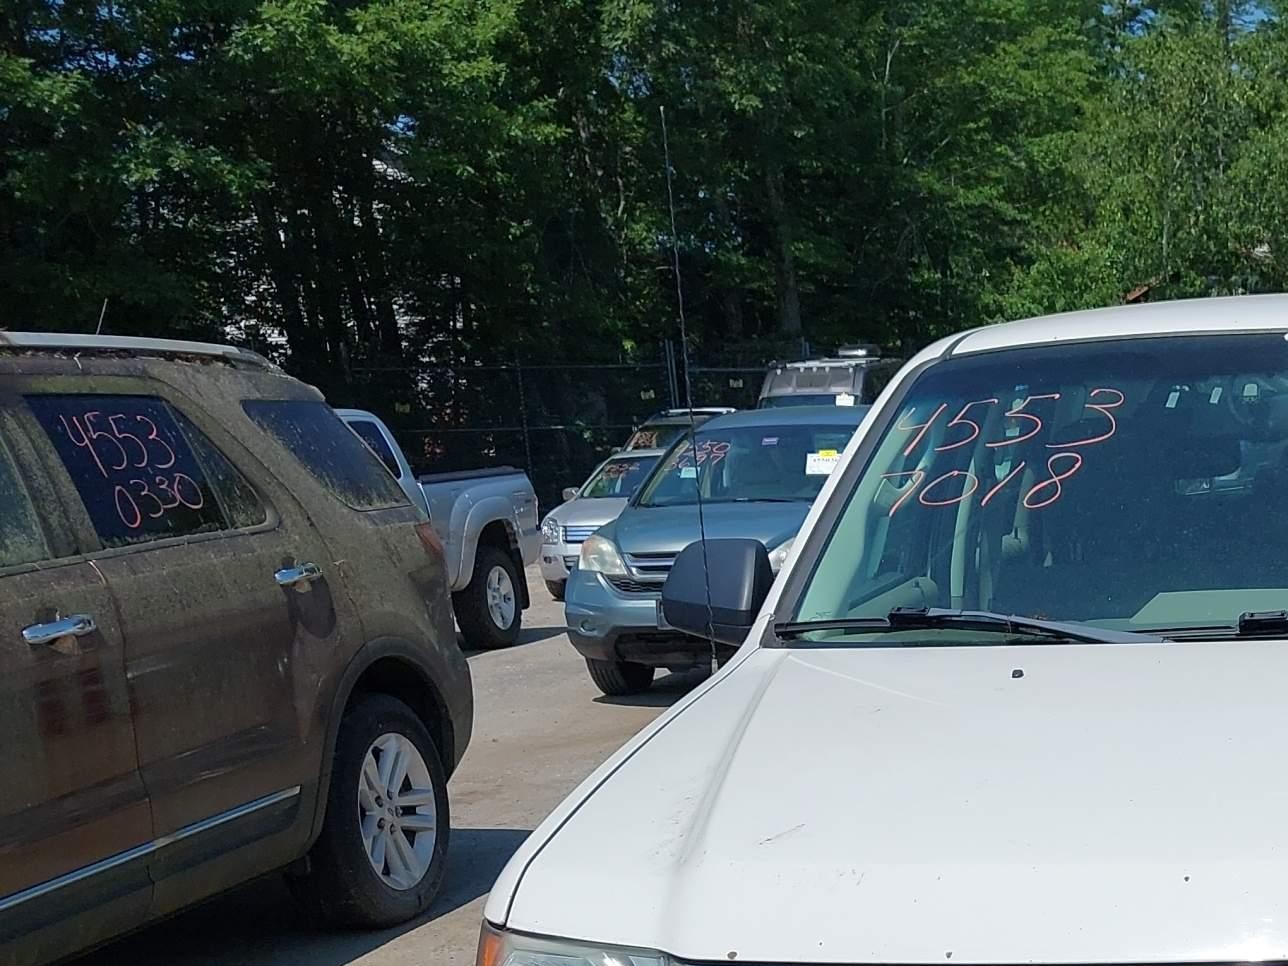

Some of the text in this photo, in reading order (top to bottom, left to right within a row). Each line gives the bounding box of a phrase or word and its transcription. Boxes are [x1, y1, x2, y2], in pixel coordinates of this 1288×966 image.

[58, 411, 176, 478] 4553
[898, 387, 1126, 456] 4553
[114, 472, 204, 528] 0330
[879, 452, 1082, 517] 7018
